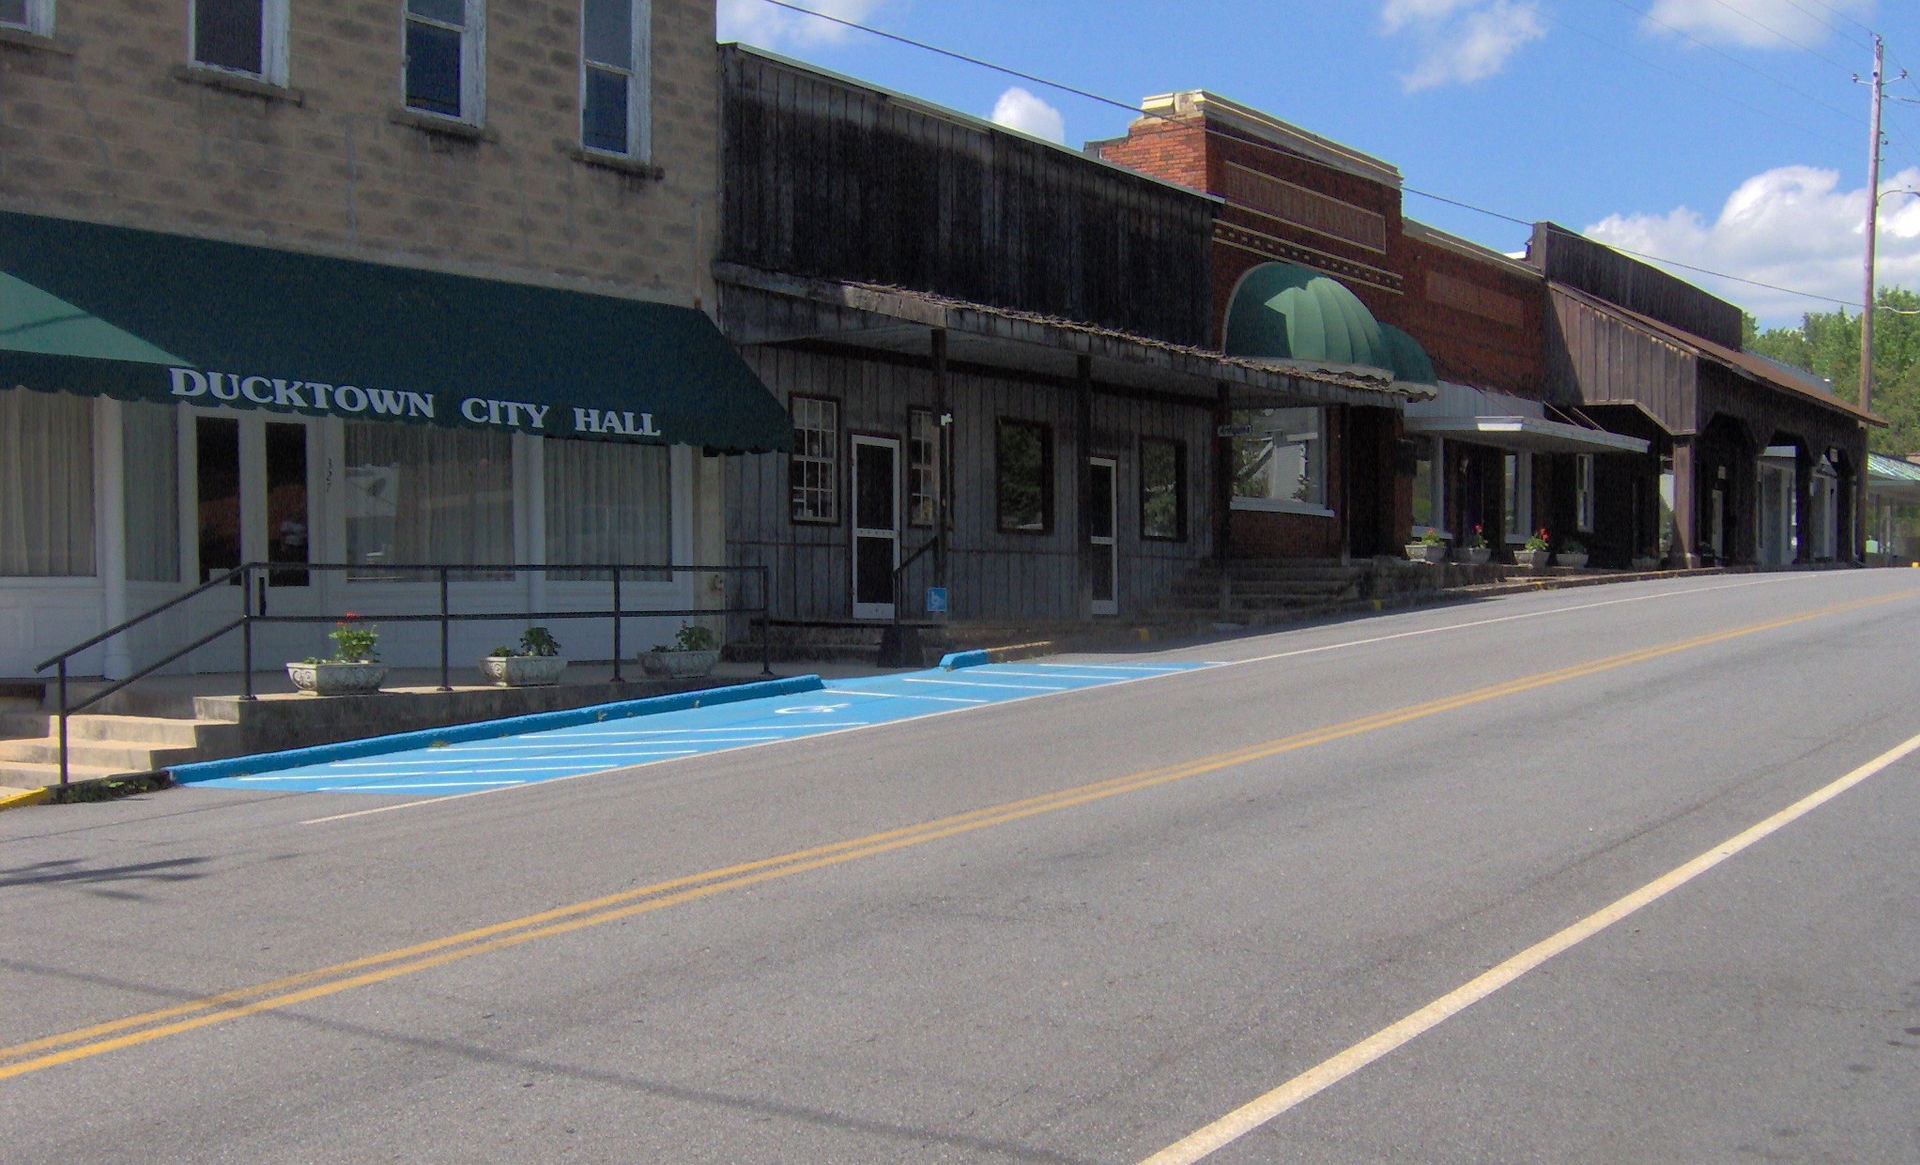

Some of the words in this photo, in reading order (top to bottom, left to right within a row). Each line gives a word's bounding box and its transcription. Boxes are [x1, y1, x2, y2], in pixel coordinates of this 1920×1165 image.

[169, 367, 434, 418] DUCKTOWN
[461, 397, 549, 428] CITY
[573, 407, 661, 436] HALL
